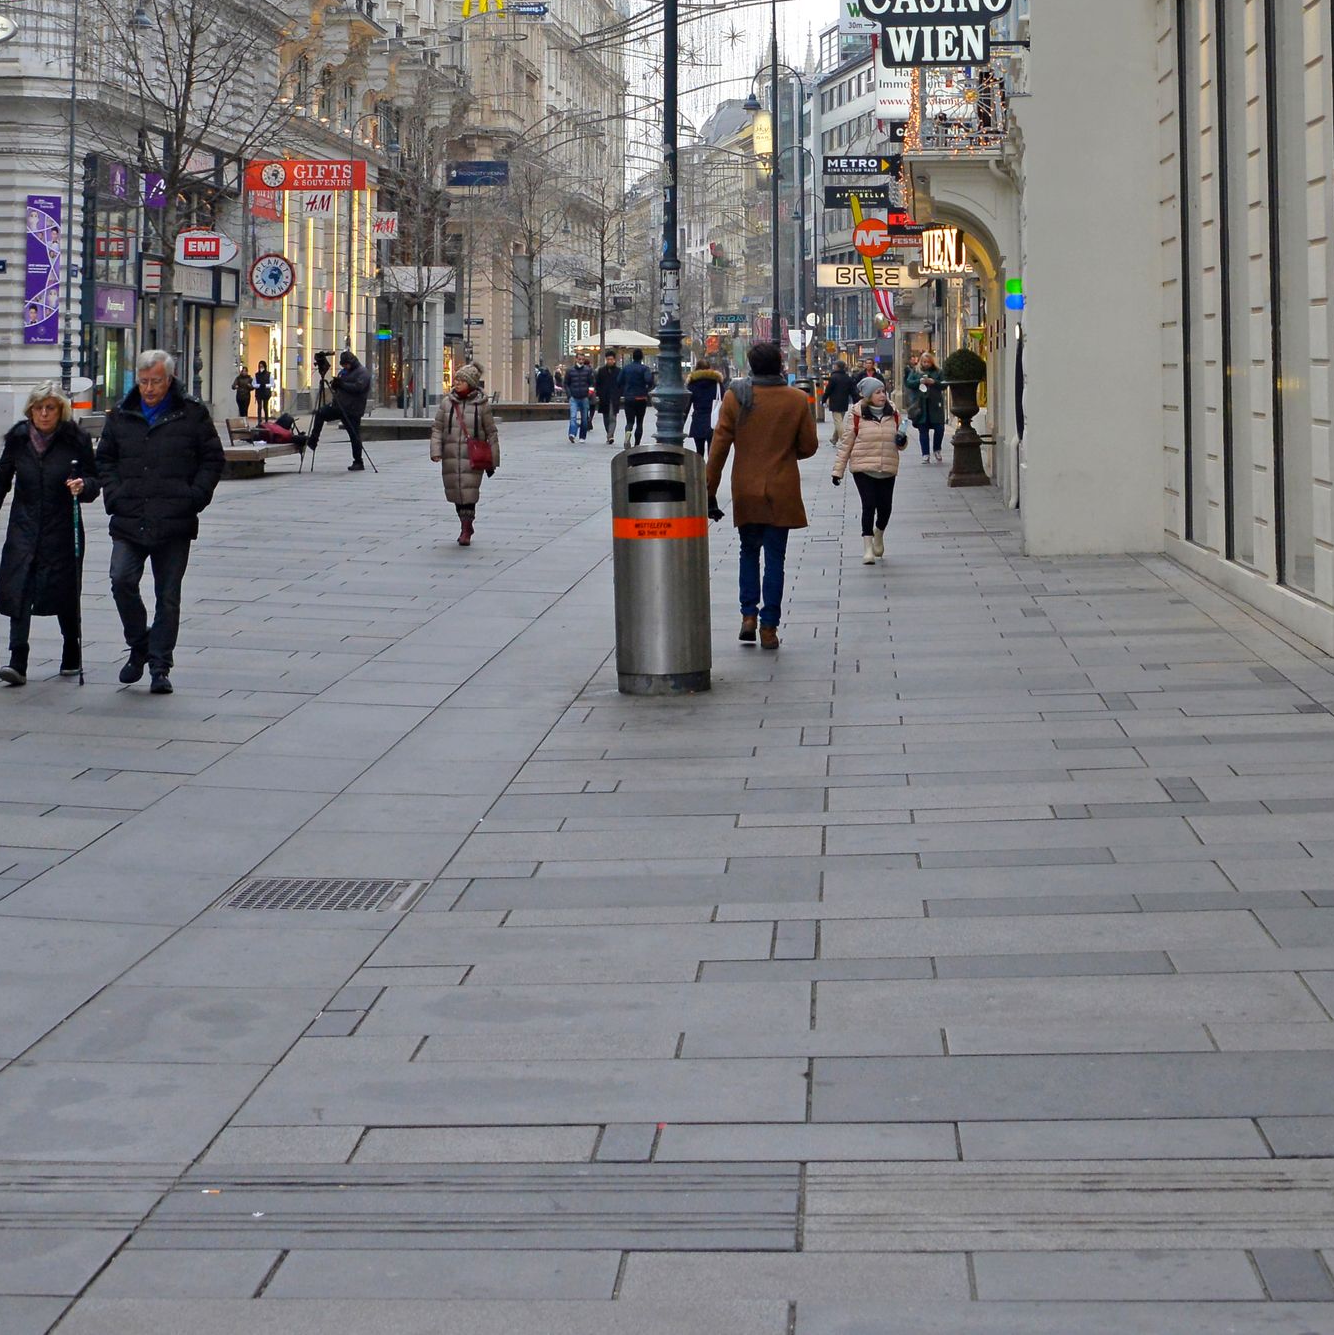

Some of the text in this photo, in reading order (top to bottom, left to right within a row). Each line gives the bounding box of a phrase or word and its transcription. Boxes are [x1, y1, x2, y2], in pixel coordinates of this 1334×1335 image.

[848, 21, 863, 29] 30m
[886, 25, 985, 62] WIEN
[827, 159, 878, 167] METRO
[293, 164, 353, 179] GIFTS
[306, 194, 332, 212] H&M
[188, 241, 216, 252] EMI
[257, 259, 288, 273] PLANET
[836, 267, 899, 285] BREE
[255, 280, 289, 295] VIENNA
